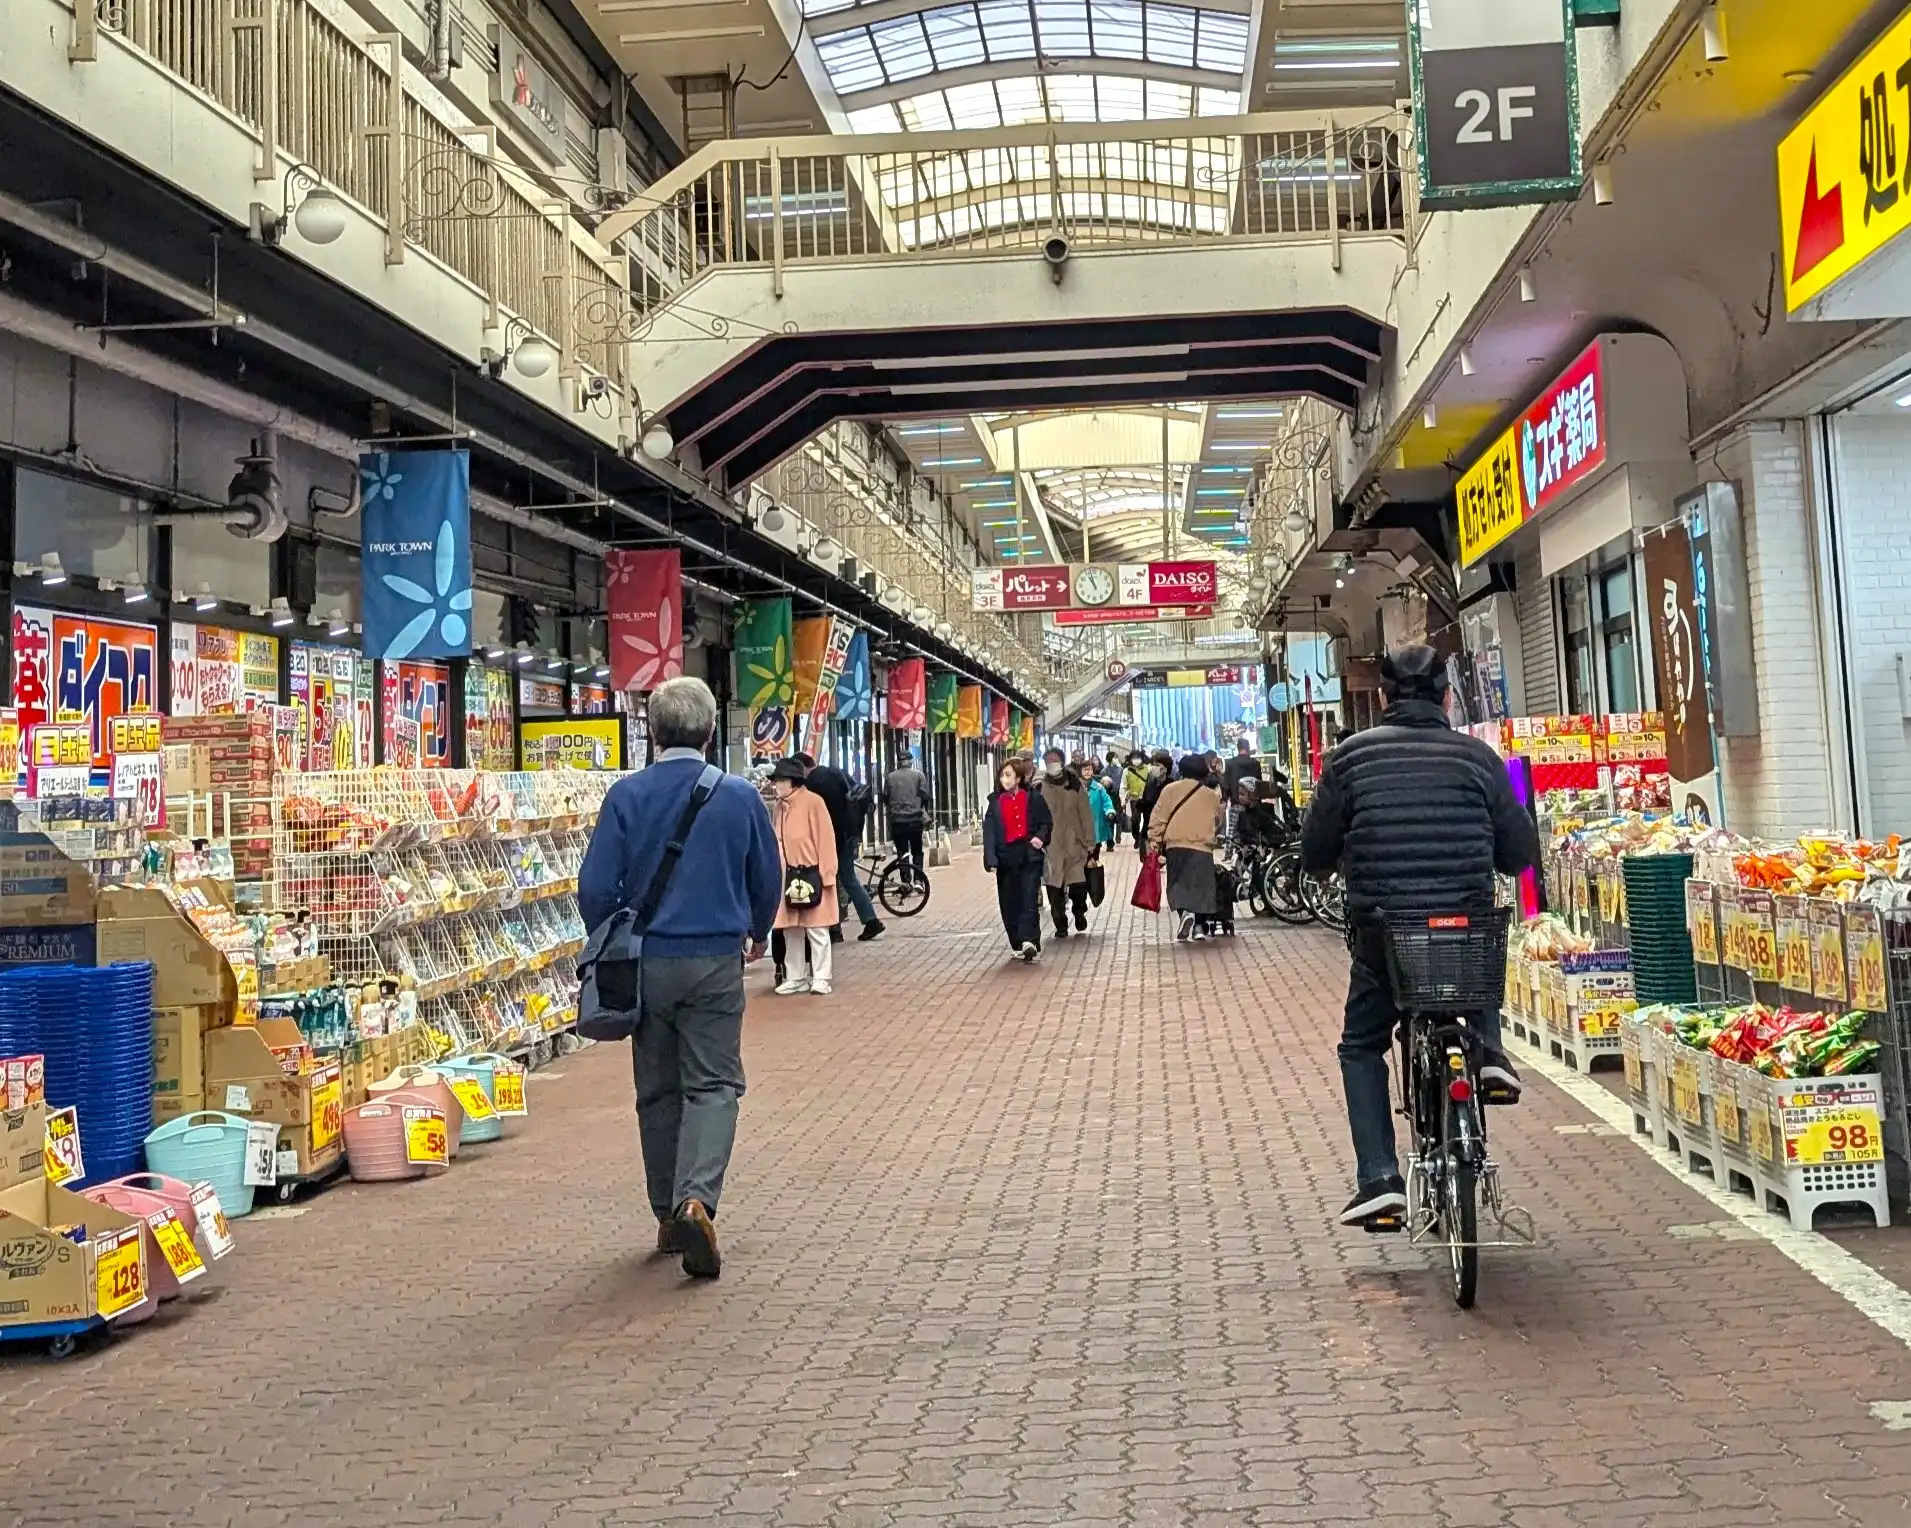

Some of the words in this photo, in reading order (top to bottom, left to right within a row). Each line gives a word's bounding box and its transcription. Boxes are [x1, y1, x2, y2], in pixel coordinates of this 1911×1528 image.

[1454, 86, 1538, 145] 2F
[1536, 373, 1597, 492] スギ薬局
[1462, 444, 1515, 551] 処方せん受付
[369, 543, 396, 553] PARK
[400, 541, 433, 552] TOWN
[1005, 574, 1051, 594] パレット
[1154, 572, 1210, 585] DAISO
[980, 595, 997, 608] 3F
[1126, 587, 1143, 600] 4F
[113, 717, 160, 753] 目玉品
[1814, 1107, 1846, 1115] スコーン
[427, 1132, 446, 1154] 58
[57, 1247, 70, 1263] S
[112, 1261, 140, 1299] 128
